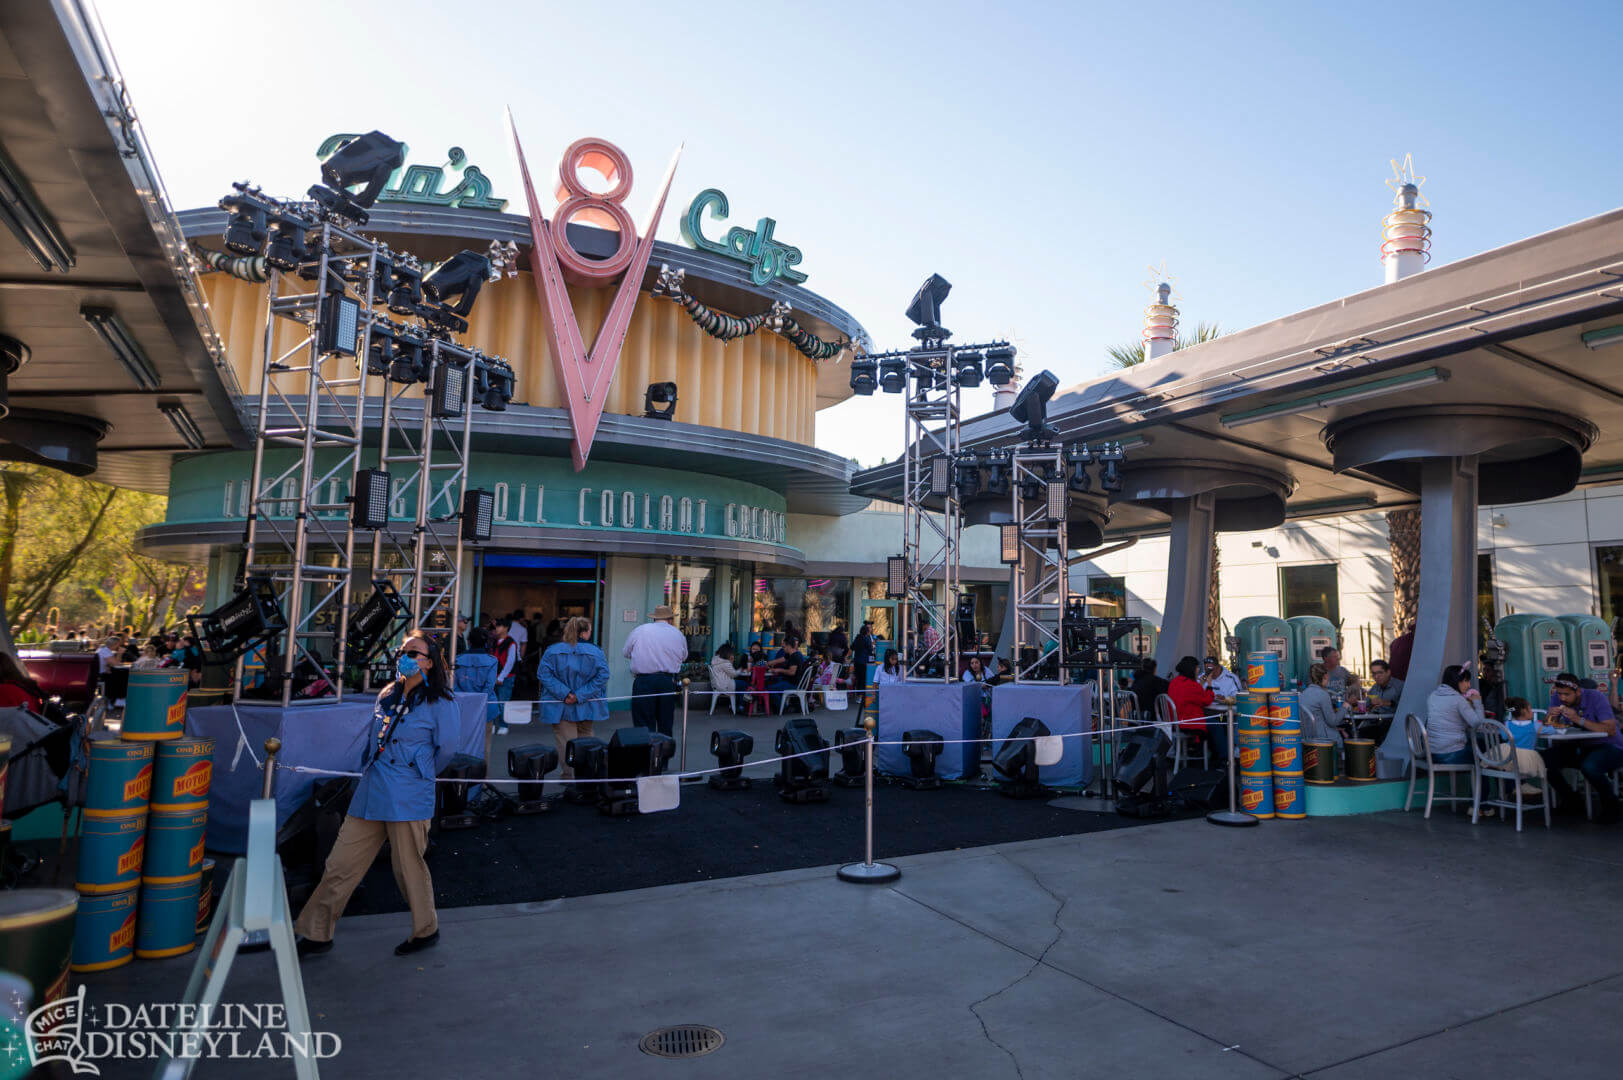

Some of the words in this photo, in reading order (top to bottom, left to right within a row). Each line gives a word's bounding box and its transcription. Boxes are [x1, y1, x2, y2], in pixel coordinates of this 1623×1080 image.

[316, 132, 509, 212] o's
[680, 188, 808, 286] Cafe
[390, 478, 458, 520] GS
[493, 482, 547, 524] OIL
[578, 488, 707, 533] COOLANT
[176, 771, 209, 792] MOTOR
